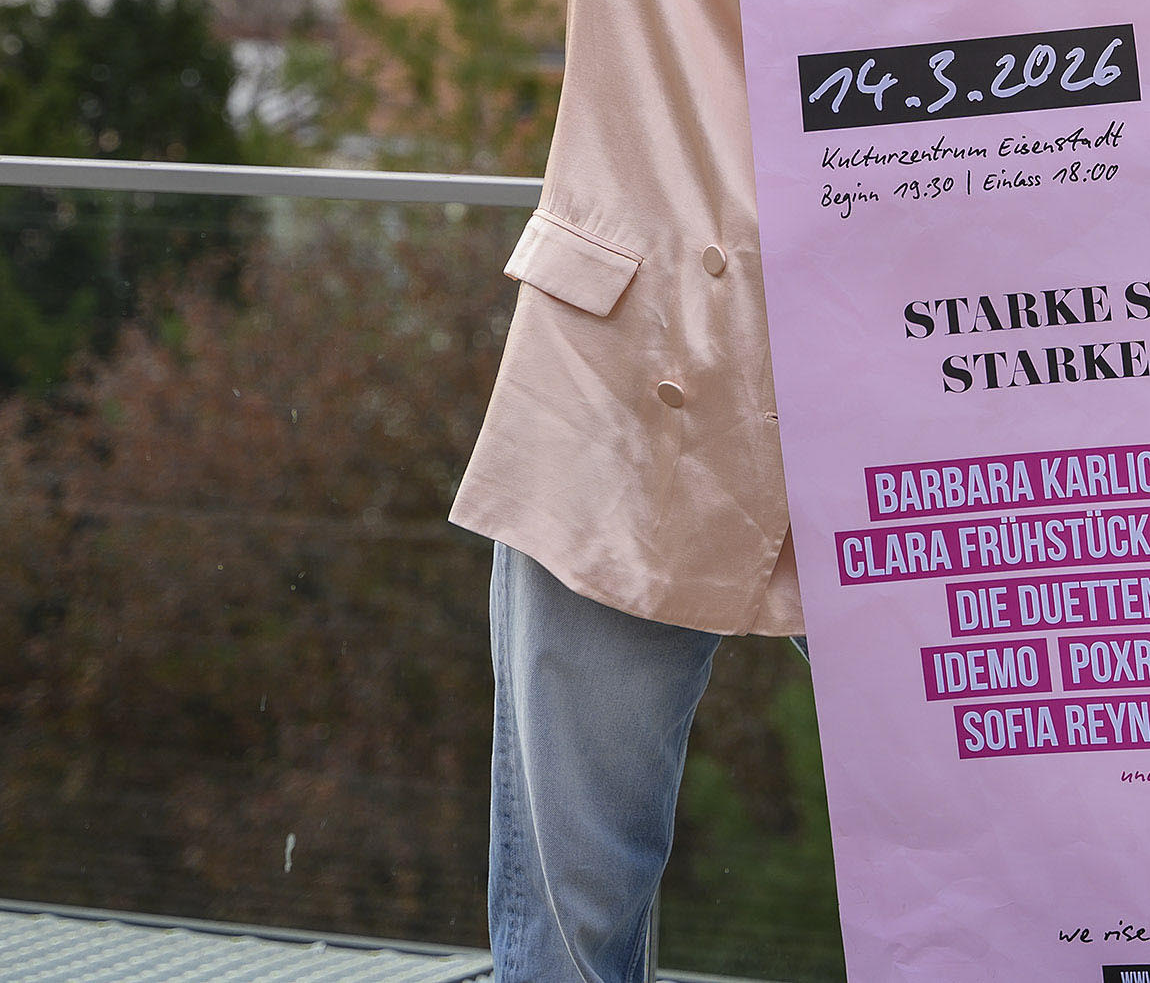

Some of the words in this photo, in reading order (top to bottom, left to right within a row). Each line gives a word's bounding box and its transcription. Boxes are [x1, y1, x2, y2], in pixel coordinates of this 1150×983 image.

[809, 38, 1123, 113] 14.3.2026
[821, 135, 988, 169] Kulturzentrum
[998, 120, 1126, 157] Eisenstadt
[821, 182, 880, 219] Beginn
[893, 177, 955, 200] 19:30
[983, 170, 1041, 191] Einlass
[1052, 161, 1119, 183] 18:00
[903, 284, 1113, 339] STARKE
[941, 339, 1150, 394] STARKE
[874, 459, 1035, 514] BARBARA
[842, 529, 953, 579] CLARA
[955, 586, 1011, 631] DIE
[933, 645, 1039, 694] IDEMO
[962, 706, 1059, 753] SOFIA
[1058, 927, 1093, 943] we
[1103, 920, 1150, 942] rise
